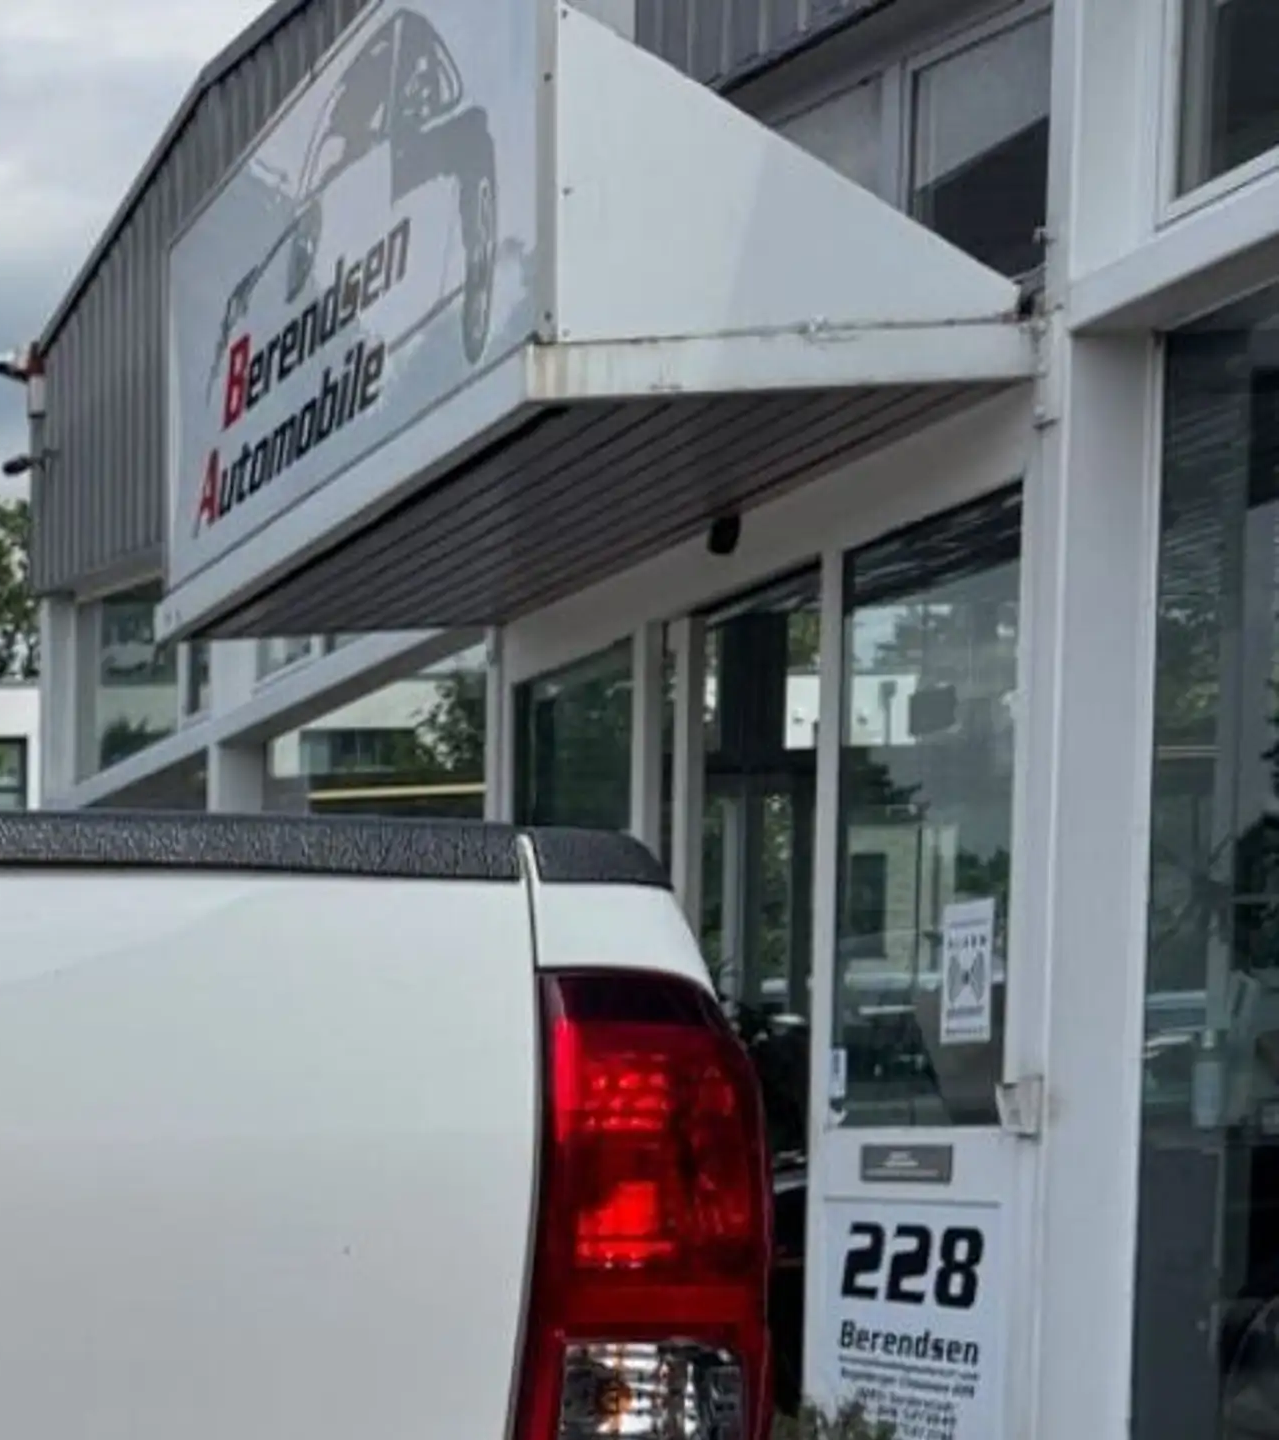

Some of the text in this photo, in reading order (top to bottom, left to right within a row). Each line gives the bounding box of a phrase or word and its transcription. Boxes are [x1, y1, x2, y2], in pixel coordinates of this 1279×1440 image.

[221, 217, 411, 432] Berendsen
[192, 340, 386, 537] Automobile
[841, 1220, 984, 1309] 228
[839, 1318, 980, 1366] Berendsen
